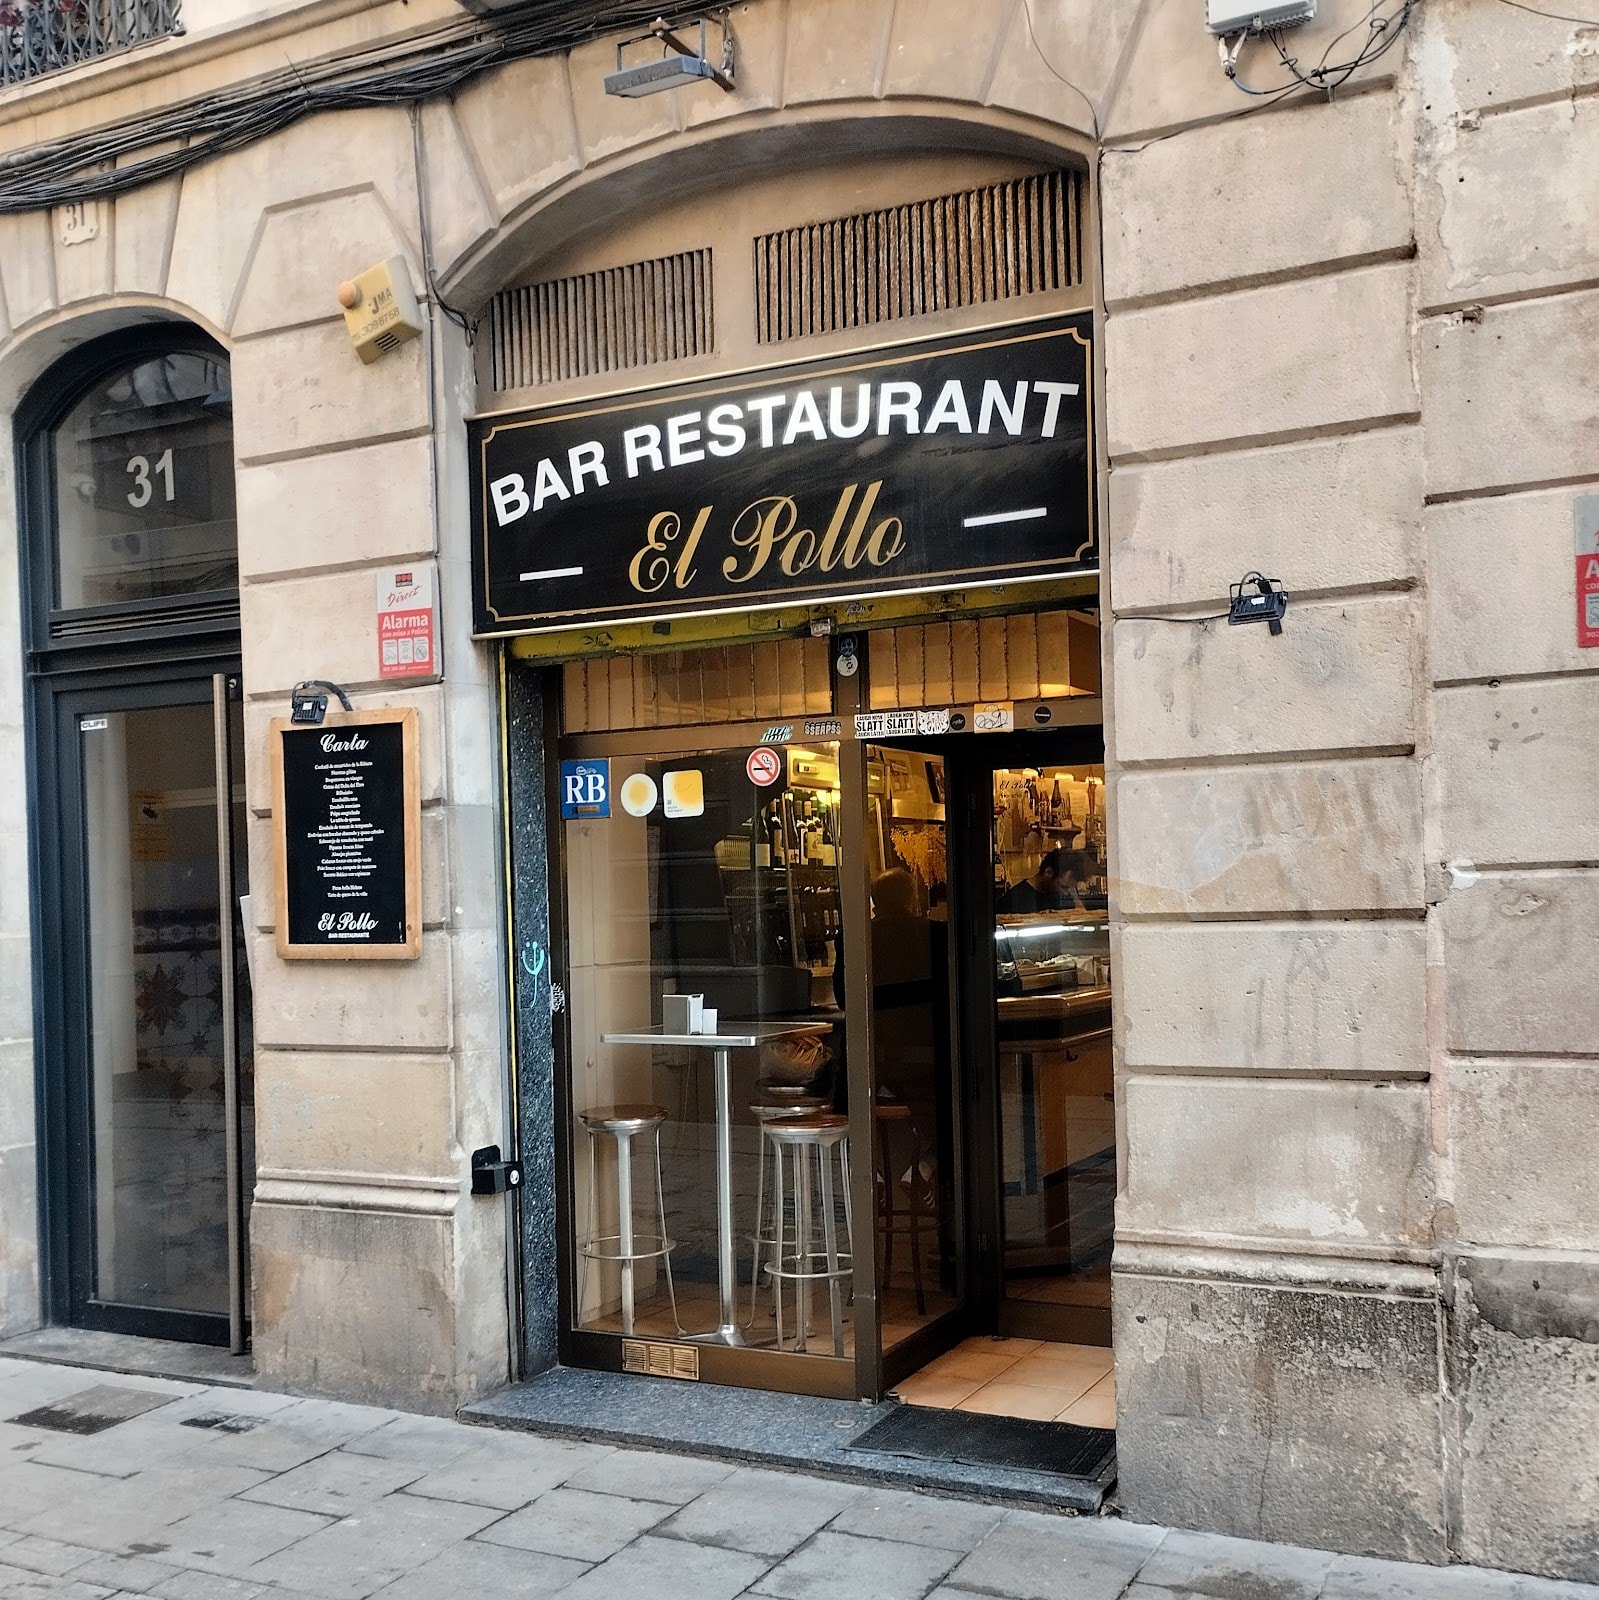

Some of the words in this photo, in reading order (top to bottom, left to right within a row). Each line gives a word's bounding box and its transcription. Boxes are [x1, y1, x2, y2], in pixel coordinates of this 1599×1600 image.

[66, 201, 85, 231] 31
[372, 288, 393, 315] JMA
[490, 441, 610, 527] BAR
[623, 379, 1079, 478] RESTAURANT
[126, 447, 175, 508] 31
[629, 505, 713, 593] El
[722, 479, 906, 584] Pollo
[387, 585, 422, 607] Direct
[382, 614, 429, 630] Alarma
[856, 721, 883, 732] SLATT
[886, 718, 914, 729] SLATT
[320, 733, 369, 752] Carta
[565, 774, 606, 804] RB
[318, 912, 336, 931] El
[337, 911, 379, 931] Pollo
